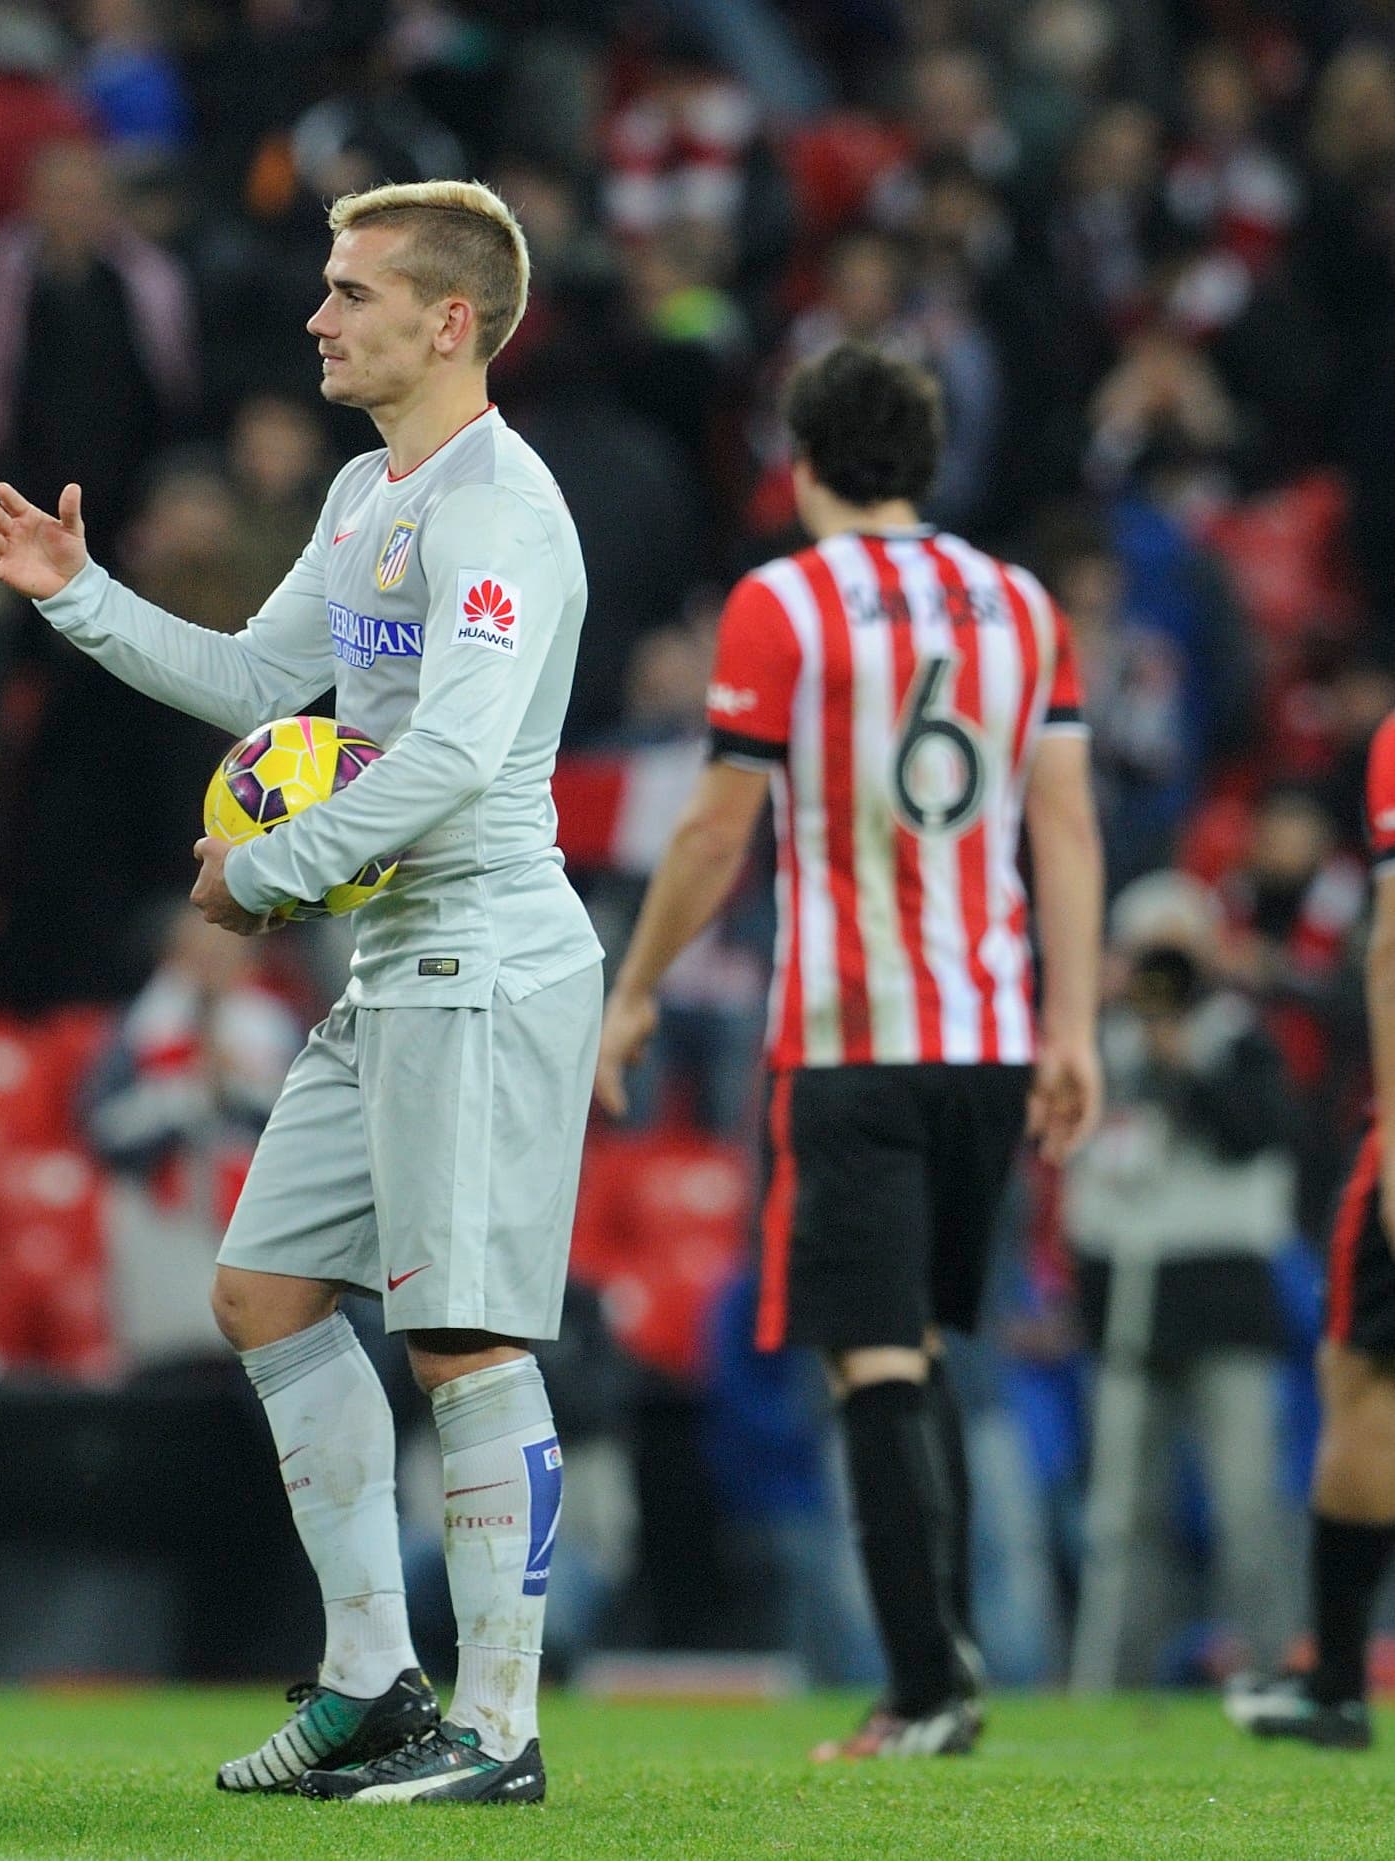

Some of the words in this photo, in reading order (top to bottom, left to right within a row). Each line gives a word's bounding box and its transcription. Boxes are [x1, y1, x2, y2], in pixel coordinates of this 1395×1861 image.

[328, 603, 423, 664] ZERBAIJAN
[458, 627, 513, 650] HUAWEI
[892, 652, 984, 833] 6
